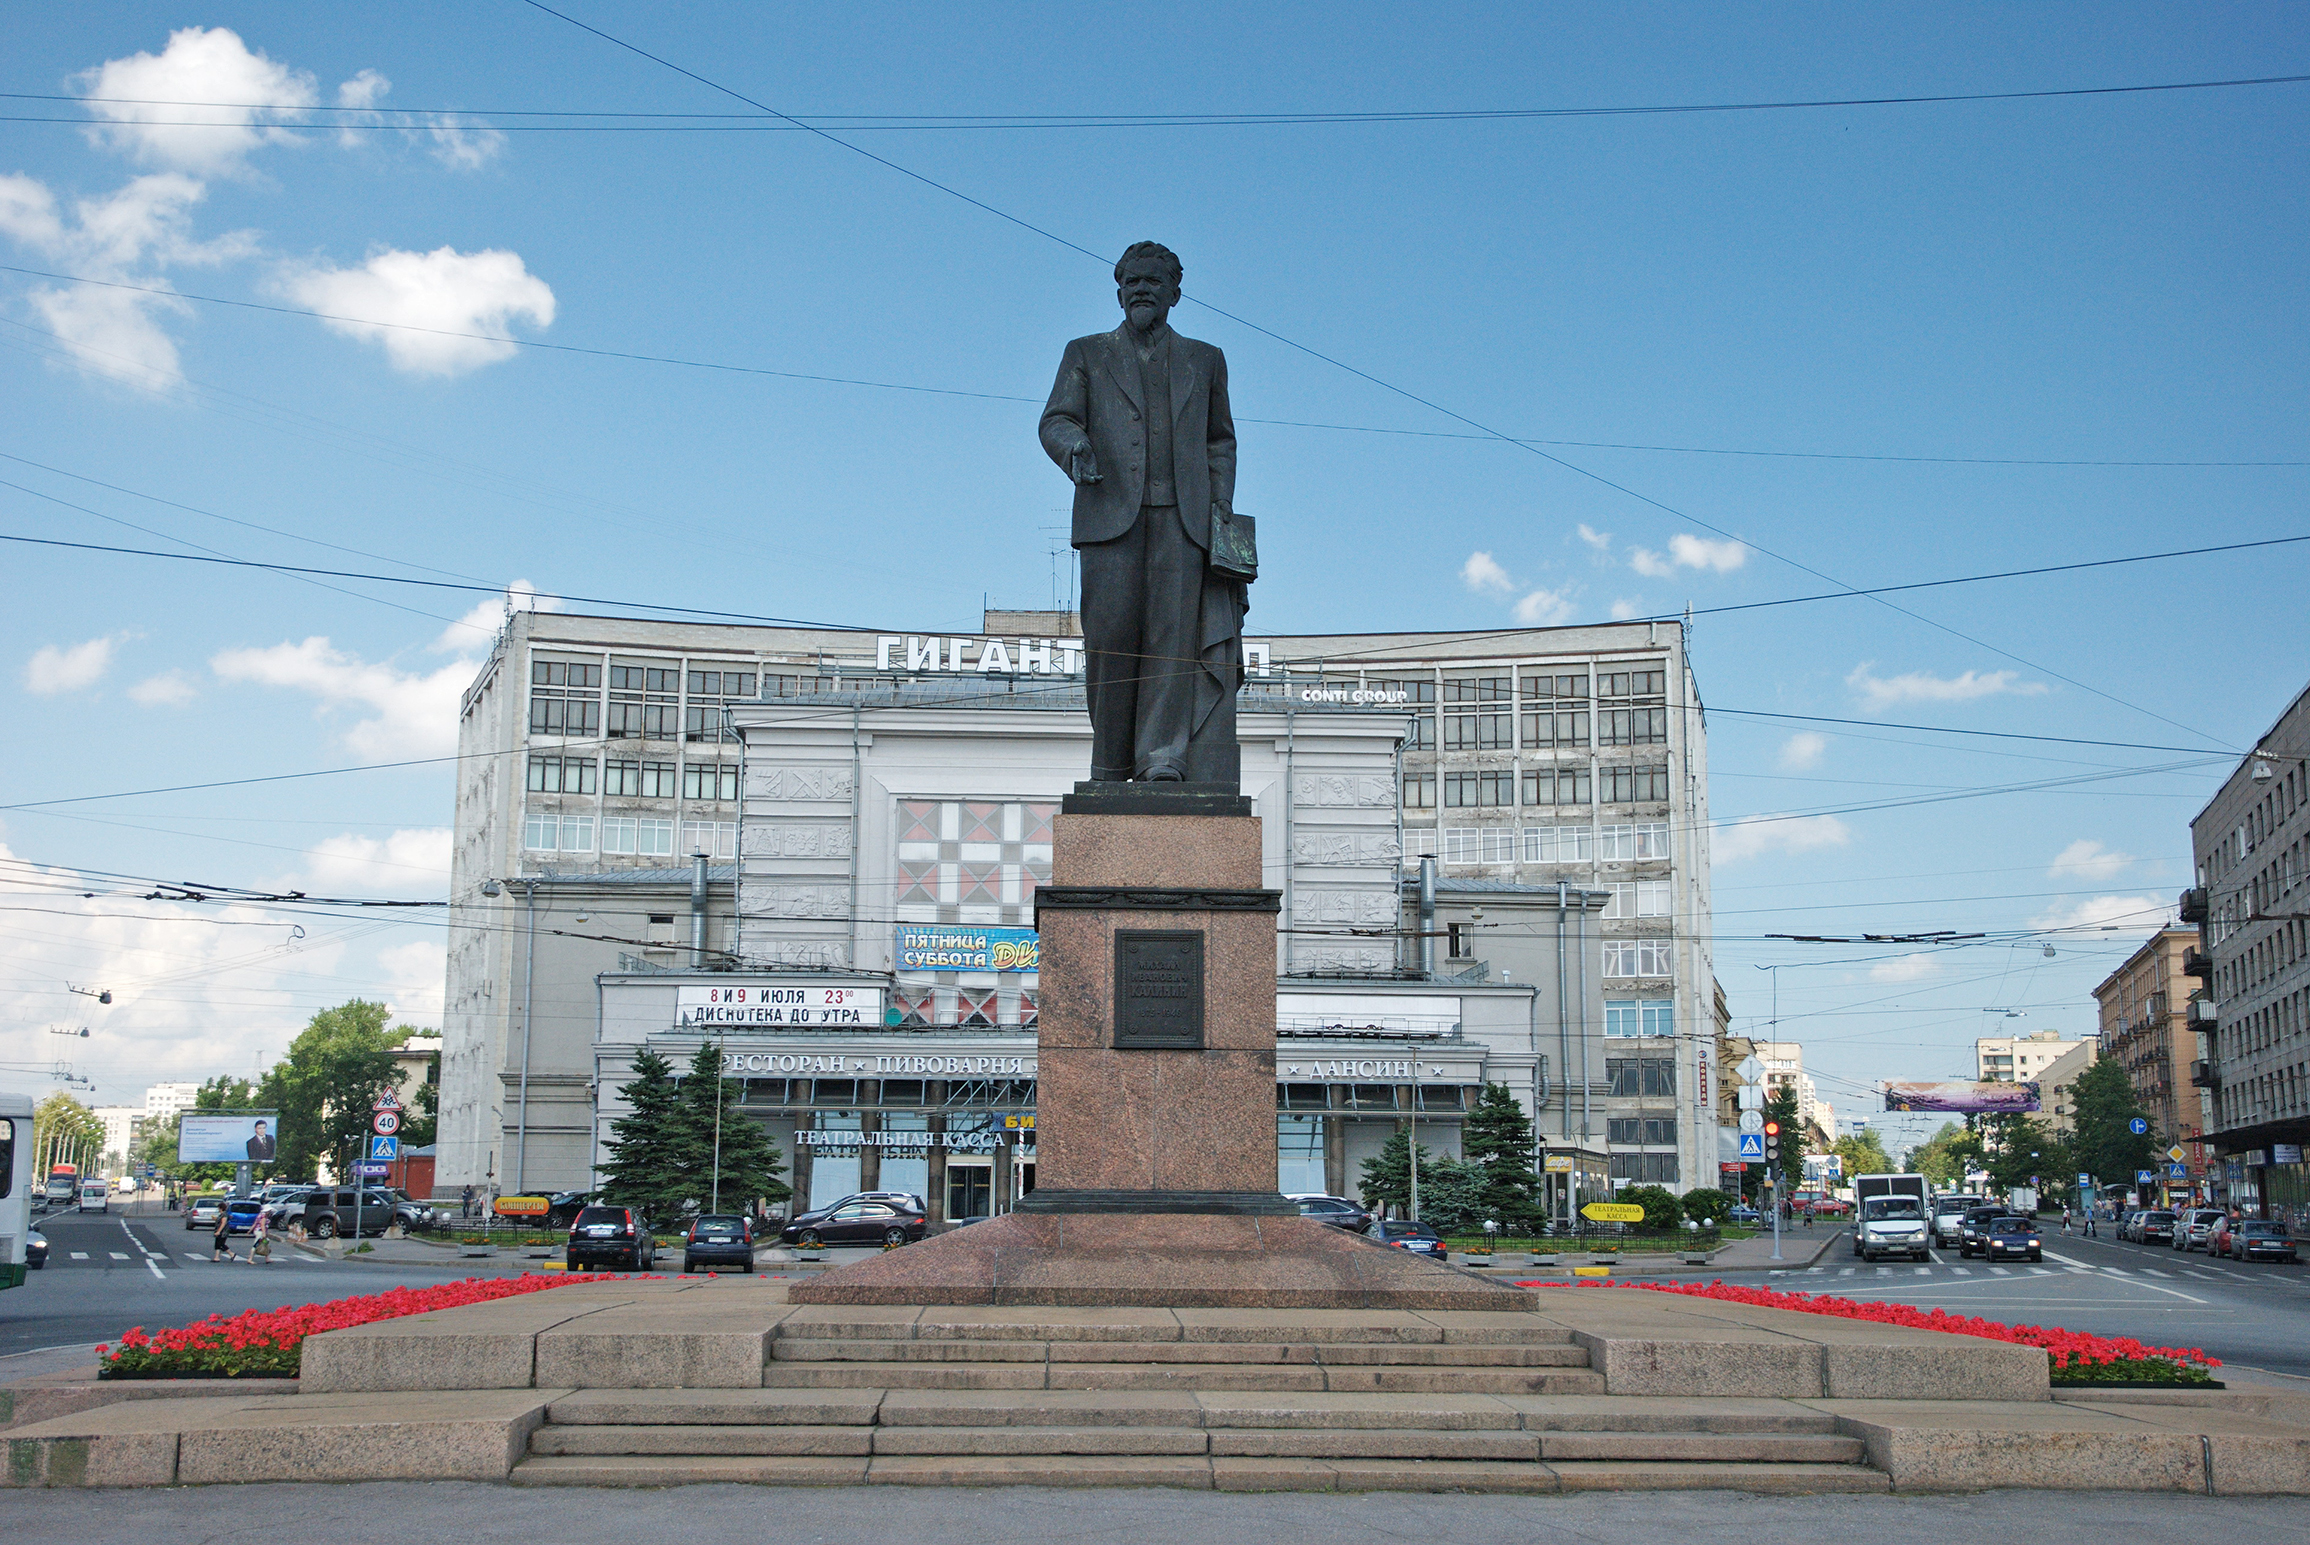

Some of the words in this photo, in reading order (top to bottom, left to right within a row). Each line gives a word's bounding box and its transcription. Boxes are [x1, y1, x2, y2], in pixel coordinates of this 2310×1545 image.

[876, 635, 1084, 675] ГИГАНТ
[1301, 689, 1347, 702] CONTI
[1352, 690, 1407, 703] GROUP
[904, 934, 987, 951] ПЯТНИЦА
[904, 952, 986, 967] СУББОТА
[710, 989, 719, 1003] 8
[724, 989, 733, 1003] И
[737, 989, 746, 1003] 9
[761, 990, 805, 1004] ИЮЛЯ
[1131, 985, 1188, 999] КАЛИНИН
[695, 1007, 783, 1023] ДИСКОТЕКА
[790, 1008, 809, 1023] ДО
[822, 1009, 861, 1023] УТРА
[875, 1056, 1024, 1074] ПИВОВАРНЯ
[1309, 1060, 1424, 1080] ДАНСИНГ
[378, 1117, 394, 1128] 40
[795, 1130, 934, 1146] ТЕАТРАЛЬНАЯ
[942, 1132, 1005, 1147] КАССА
[500, 1201, 544, 1211] КОНЦЕРТЫ
